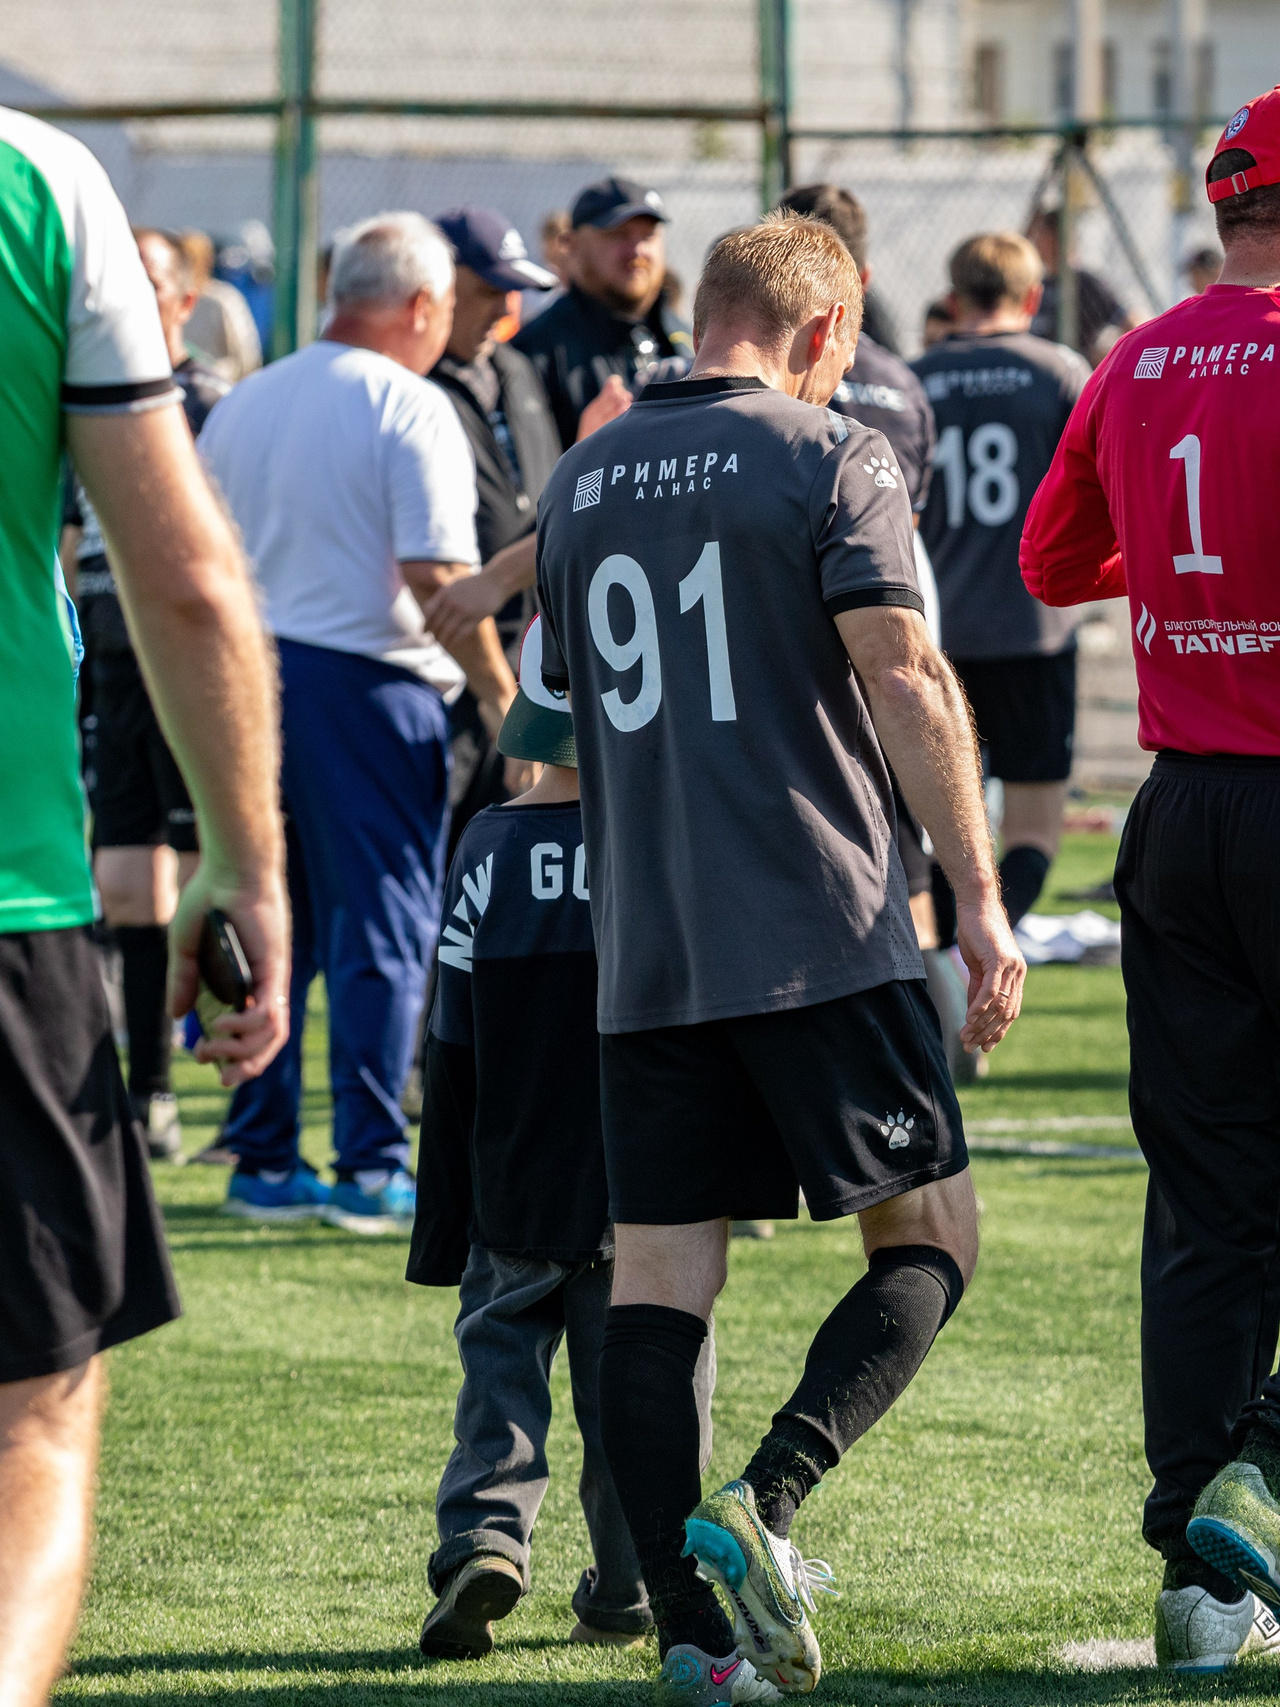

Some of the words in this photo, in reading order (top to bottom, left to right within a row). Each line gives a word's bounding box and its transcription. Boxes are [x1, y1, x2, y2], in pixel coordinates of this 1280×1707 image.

[1172, 342, 1275, 365] РИМЕРА
[1188, 363, 1250, 379] АЛНАС
[610, 452, 738, 485] РИМЕРА
[930, 422, 1020, 529] 18
[635, 477, 711, 500] АЛНАС
[1169, 434, 1224, 575] 1
[588, 540, 737, 733] 91
